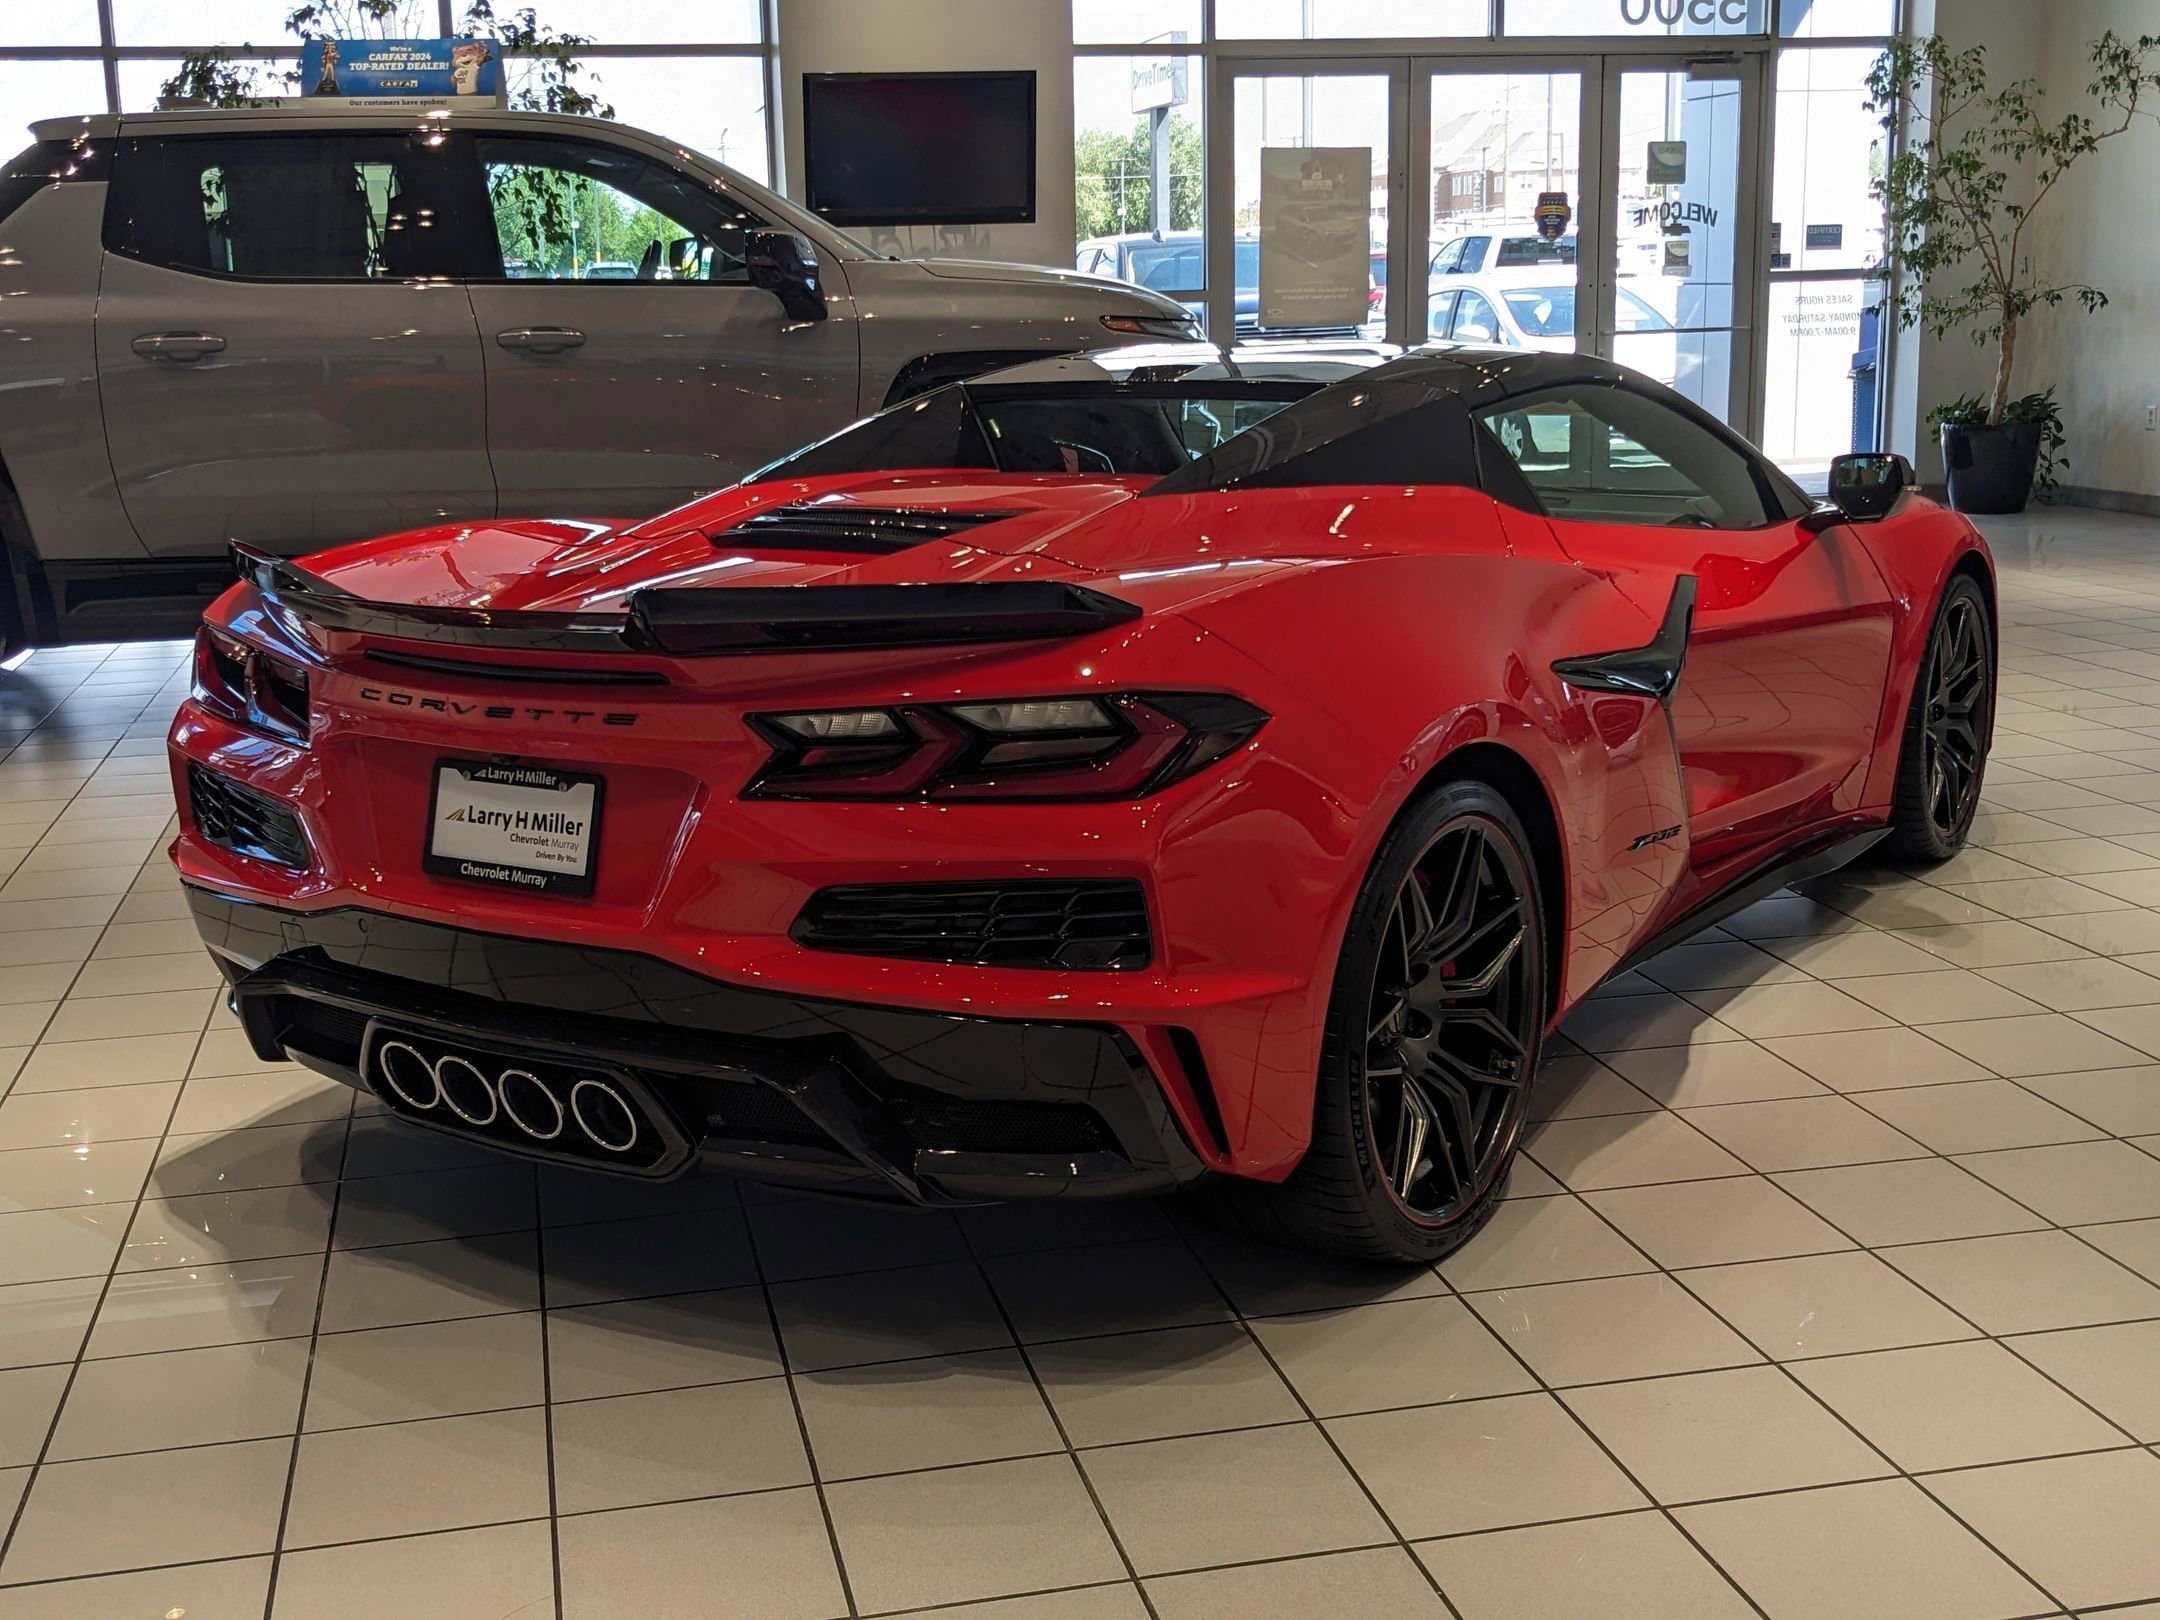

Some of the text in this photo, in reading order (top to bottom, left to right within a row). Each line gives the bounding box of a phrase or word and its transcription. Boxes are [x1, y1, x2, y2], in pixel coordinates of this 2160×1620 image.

[349, 62, 449, 71] TOP-RATED DEALER!
[368, 53, 432, 61] CARFAX 2024
[379, 80, 418, 88] CARFAX
[1132, 62, 1173, 90] DriveTime
[420, 99, 447, 107] spoken!
[360, 687, 638, 726] CORVETTE
[487, 766, 557, 786] Larry H Miller
[467, 804, 584, 837] Larry H Miller
[509, 832, 580, 852] Chevrolet Murray
[535, 850, 556, 861] Driven
[557, 853, 565, 863] By
[460, 862, 548, 888] Chevrolet Murray
[1350, 1058, 1369, 1166] MICHELIN
